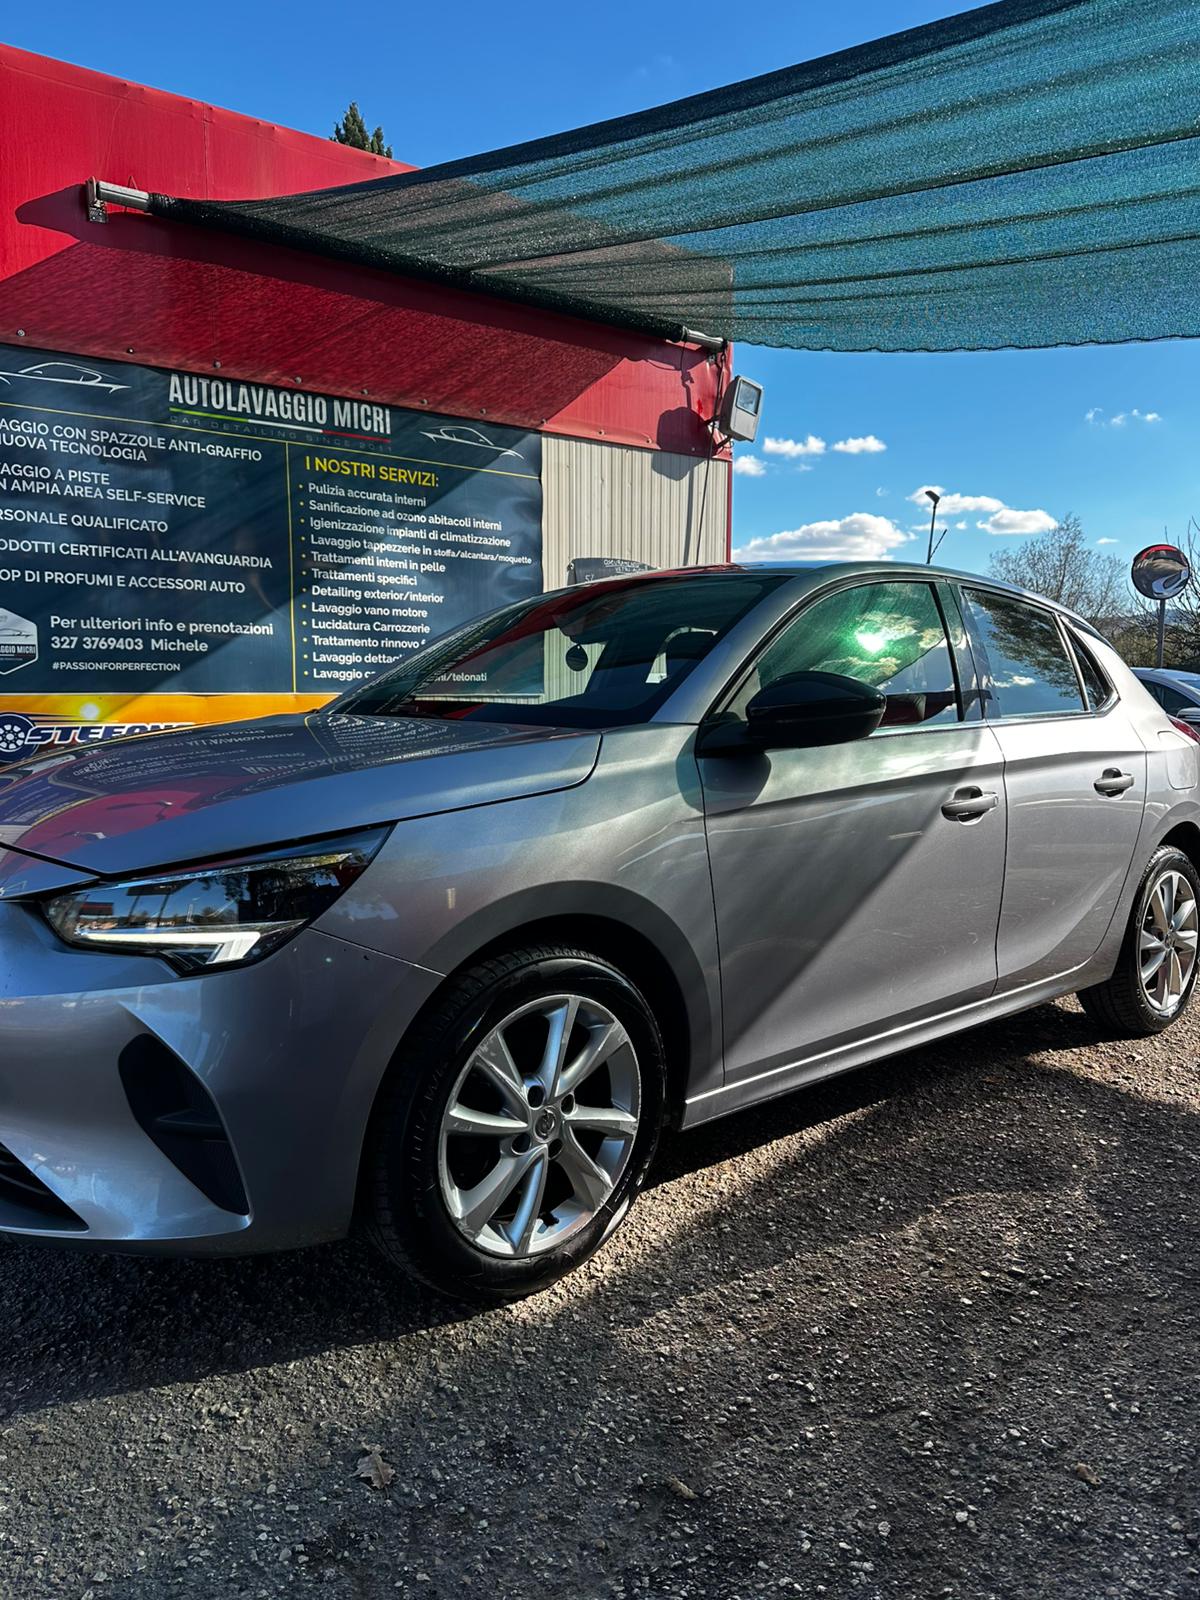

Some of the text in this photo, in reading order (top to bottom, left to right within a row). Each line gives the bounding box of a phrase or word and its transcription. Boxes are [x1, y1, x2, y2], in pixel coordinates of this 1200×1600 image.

[169, 374, 391, 435] AUTOLAVAGGIO MICRI
[169, 415, 201, 427] CAR
[211, 421, 297, 440] DETAILING
[50, 440, 147, 461] TECNOLOGIA
[53, 425, 86, 440] CON
[91, 430, 165, 450] SPAZZOLE
[169, 440, 262, 461] ANTI-GRAFFIO
[55, 469, 64, 481] A
[69, 470, 110, 484] PISTE
[306, 456, 439, 487] I NOSTRI SERVIZI:
[11, 481, 60, 495] AMPIA
[64, 484, 103, 499] AREA
[107, 489, 206, 508] SELF-SERVICE
[308, 483, 426, 507] Pulizia accurata interni
[71, 514, 168, 533] QUALIFICATO
[309, 501, 502, 531] Sanificazione ad ozono abitacoli interni
[310, 517, 511, 547] Igienizzazione impianti di climatizzazione
[59, 543, 148, 560] CERTIFICATI
[151, 548, 272, 568] ALL'AVANGUARDIA
[311, 535, 532, 564] Lavaggio tappezzerie in stoffa/alcantara/moquette
[311, 552, 446, 573] Trattamenti interni in pelle
[25, 570, 40, 583] DI
[44, 572, 113, 586] PROFUMI
[117, 575, 125, 587] E
[128, 576, 207, 592] ACCESSORI
[209, 580, 246, 593] AUTO
[312, 569, 417, 586] Trattamenti specifici
[312, 585, 444, 604] Detailing exterior/interior
[312, 603, 428, 618] Lavaggio vano motore
[50, 615, 273, 636] Per ulteriori info e prenotazioni
[312, 620, 430, 633] Lucidatura Carrozzerie
[17, 646, 35, 654] MICRI
[51, 637, 208, 652] 327 3769403 Michele
[312, 635, 378, 648] Trattamento
[381, 638, 419, 648] rinnovo
[52, 662, 180, 671] #PASSIONFORPERFECTION
[313, 652, 362, 665] Lavaggio
[313, 669, 362, 681] Lavaggio
